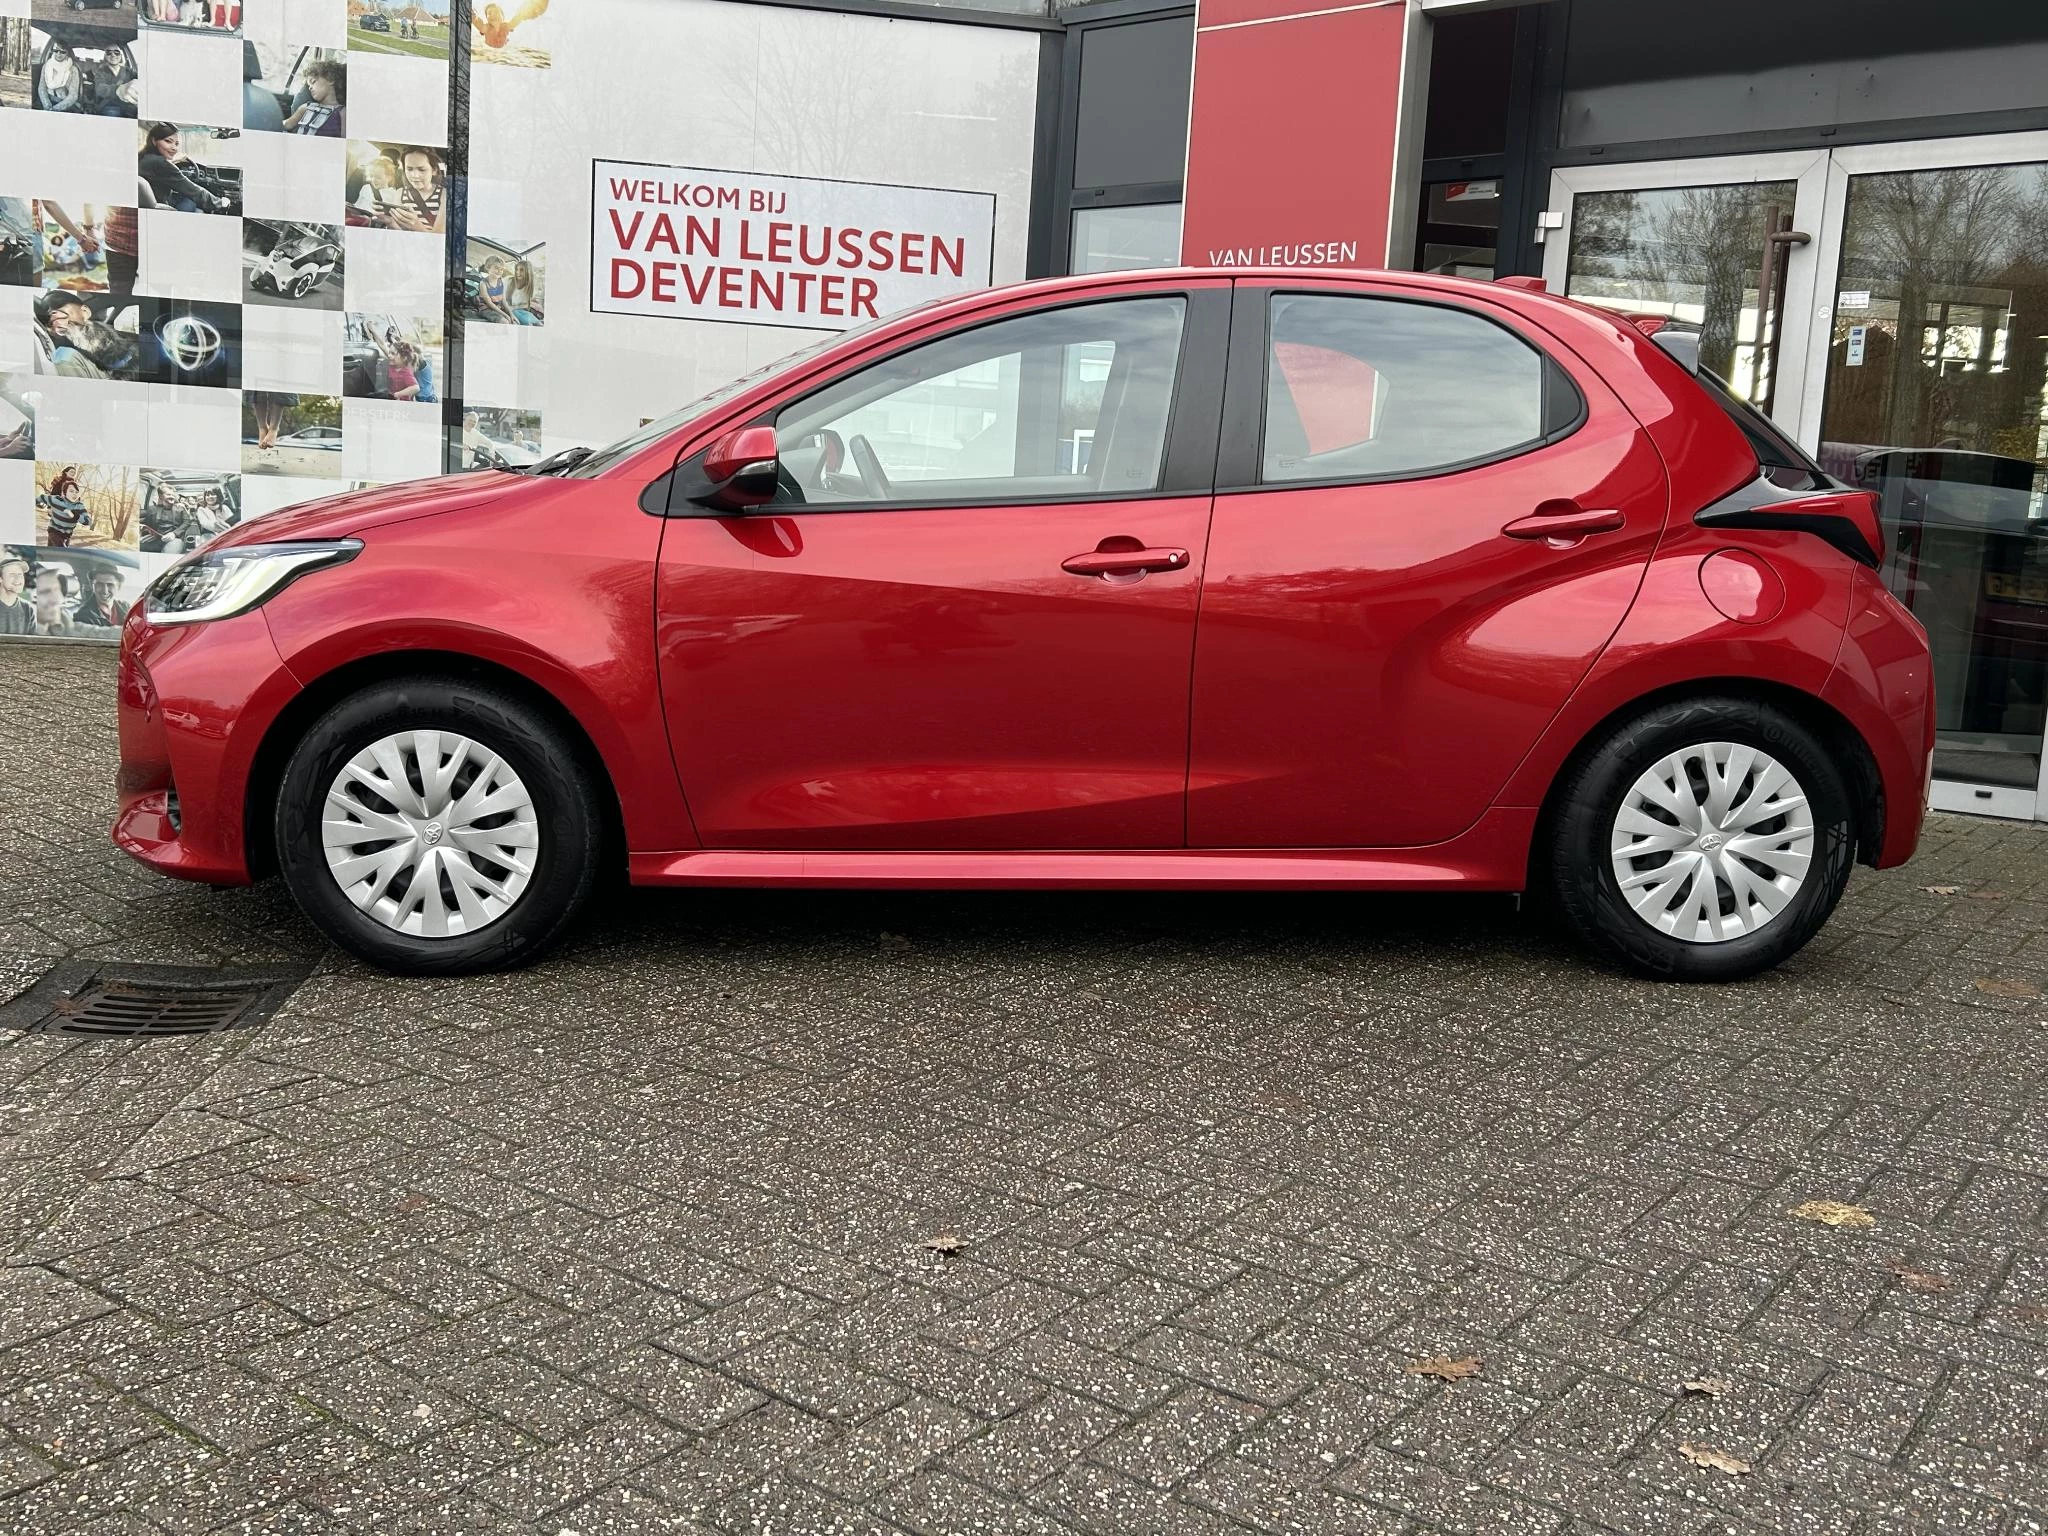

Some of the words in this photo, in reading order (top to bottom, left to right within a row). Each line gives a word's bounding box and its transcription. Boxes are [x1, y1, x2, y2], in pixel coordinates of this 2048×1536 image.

[609, 177, 741, 211] WELKOM
[749, 189, 787, 214] BIJ
[608, 208, 721, 258] VAN
[739, 219, 965, 278] LEUSSEN
[1209, 247, 1253, 266] VAN
[1259, 240, 1357, 266] LEUSSEN
[610, 257, 880, 319] DEVENTER
